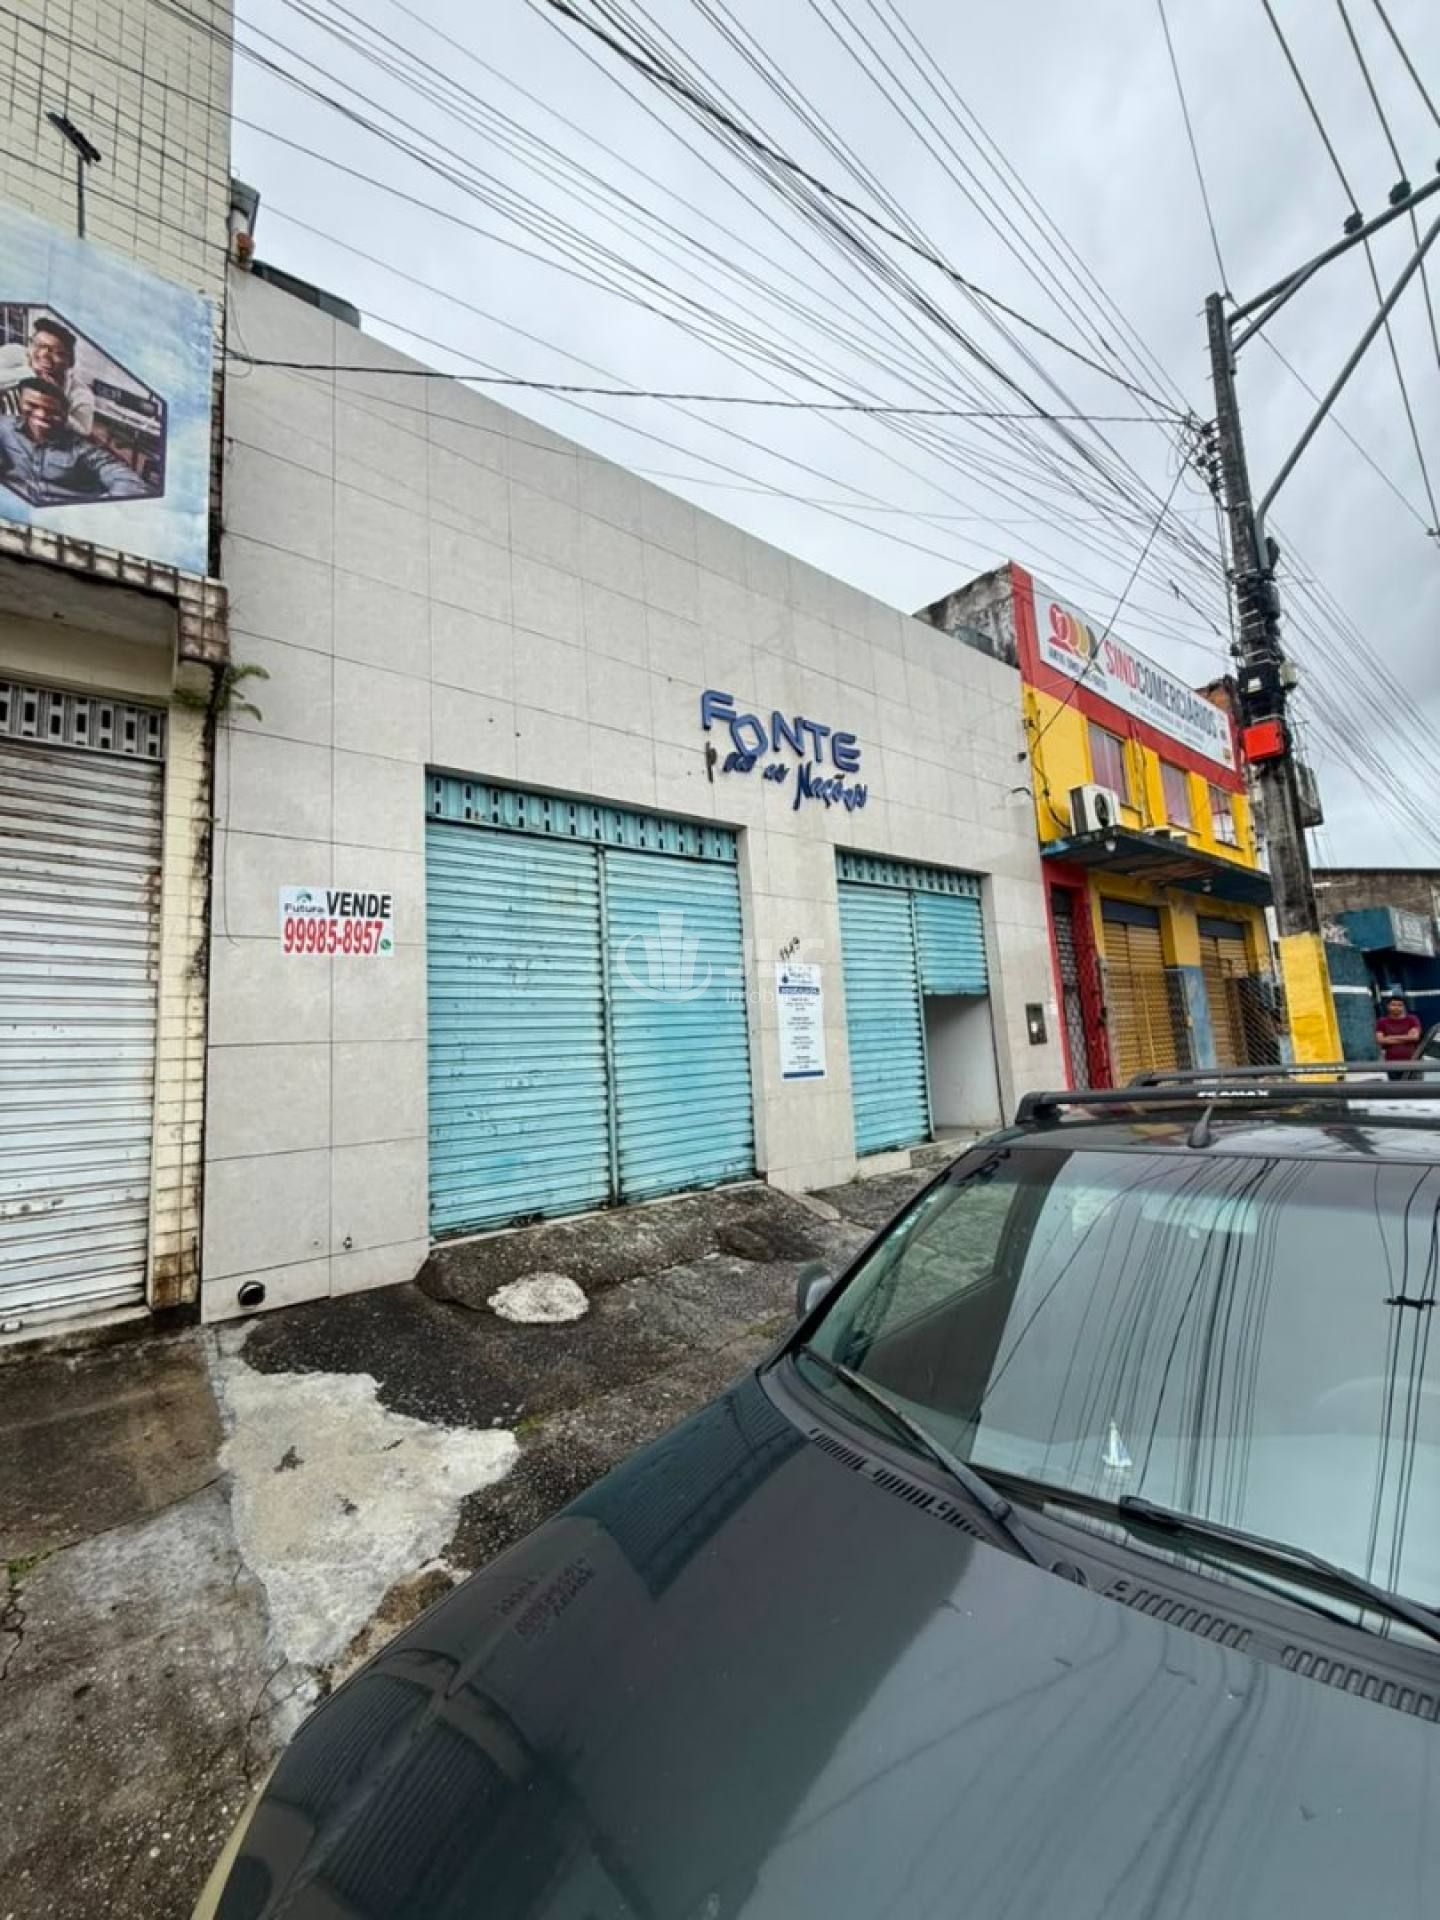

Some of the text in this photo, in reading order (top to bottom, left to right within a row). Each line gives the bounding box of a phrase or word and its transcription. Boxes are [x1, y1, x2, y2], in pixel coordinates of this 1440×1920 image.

[701, 689, 861, 773] FONTE
[326, 890, 392, 918] VENDE
[284, 917, 383, 954] 99985-8957
